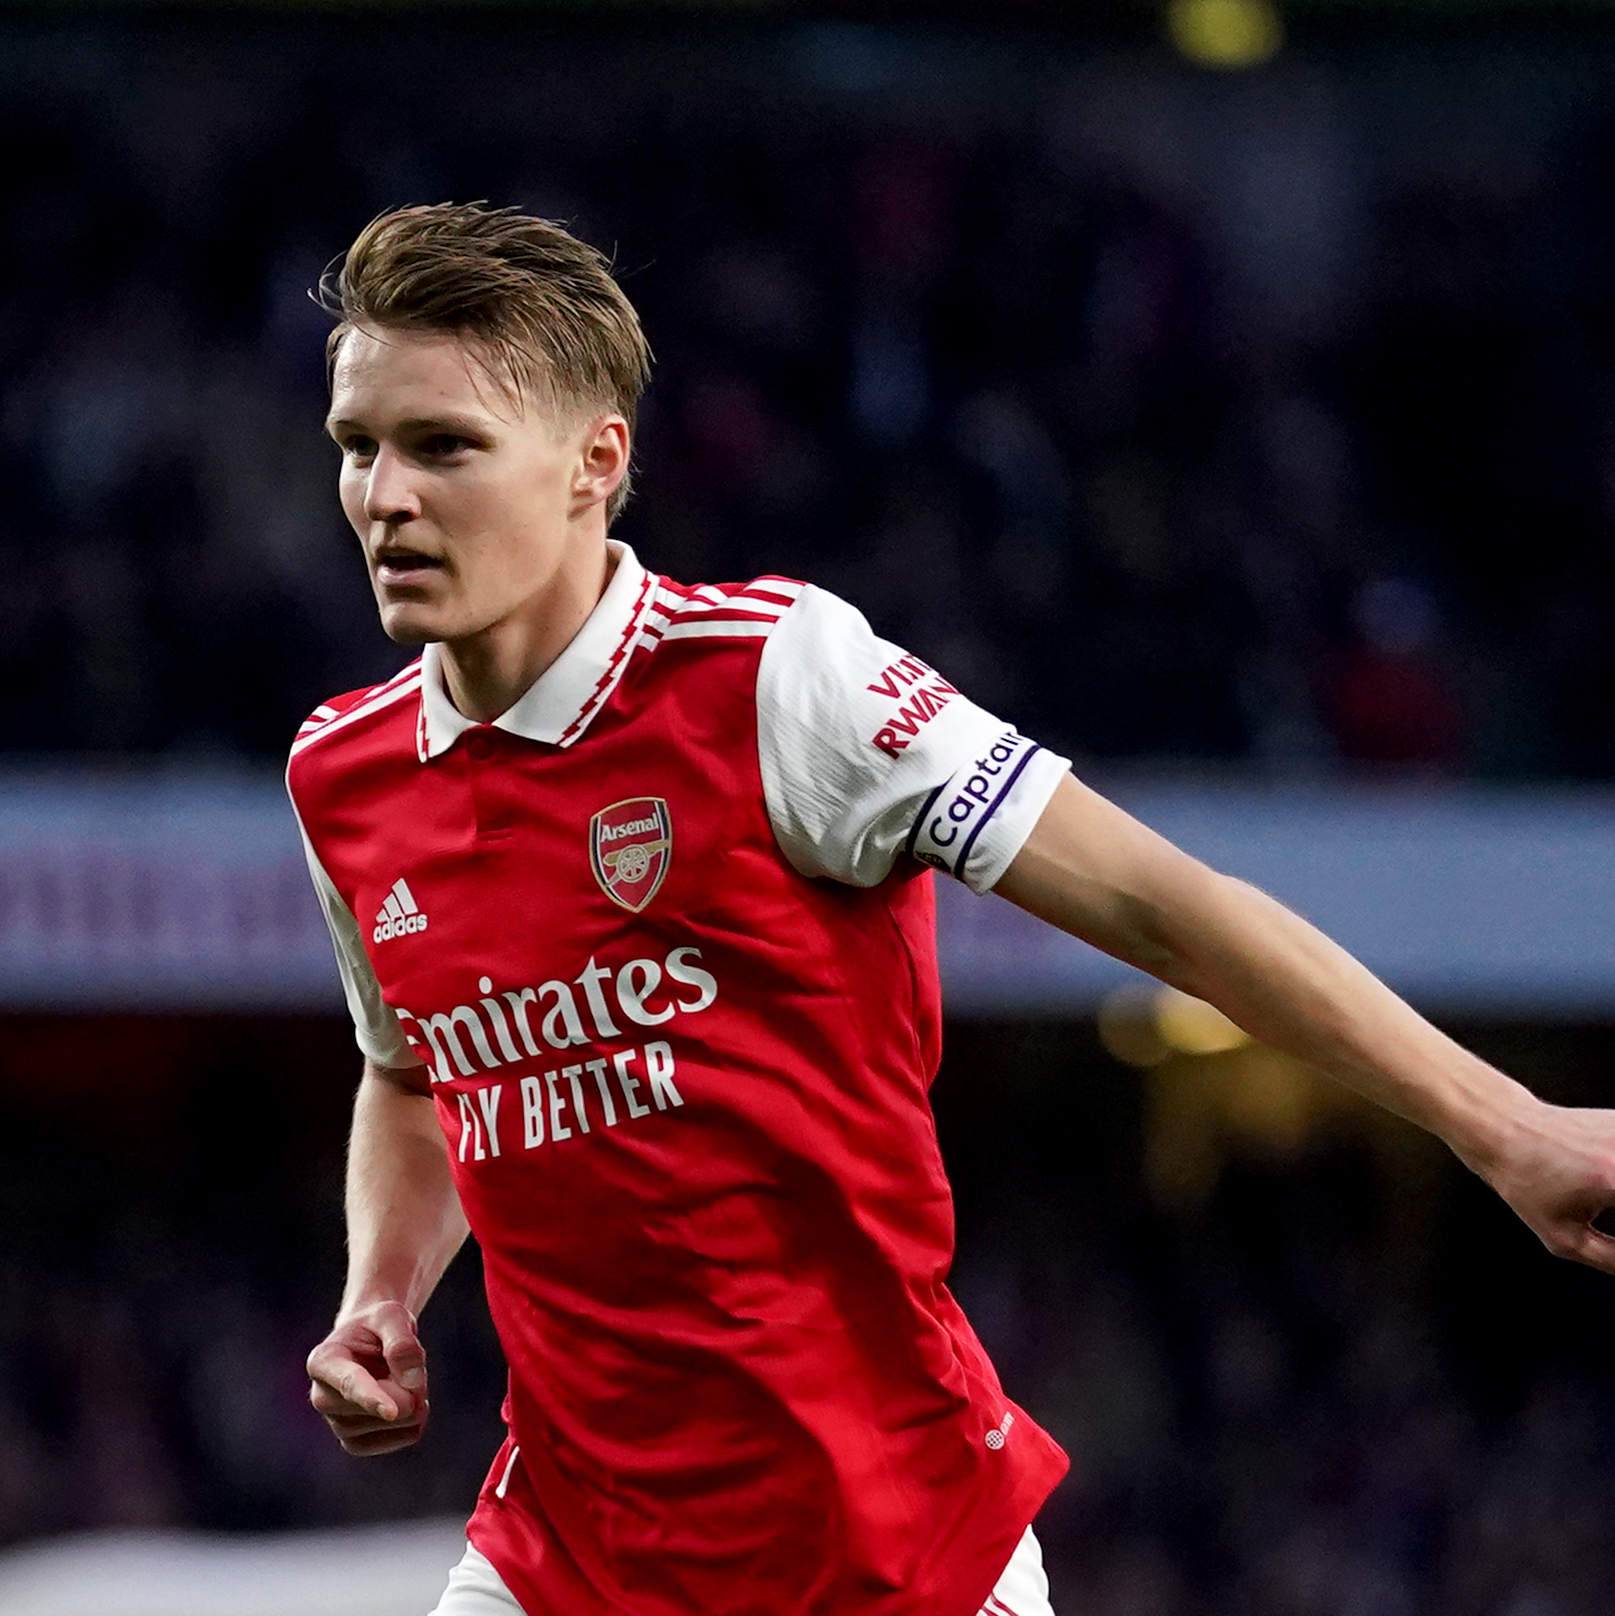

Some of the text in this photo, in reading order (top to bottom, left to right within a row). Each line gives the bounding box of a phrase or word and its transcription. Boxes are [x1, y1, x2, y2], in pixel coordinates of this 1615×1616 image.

[600, 812, 660, 843] Arsenal
[373, 913, 428, 944] adidas
[520, 1040, 685, 1150] BETTER
